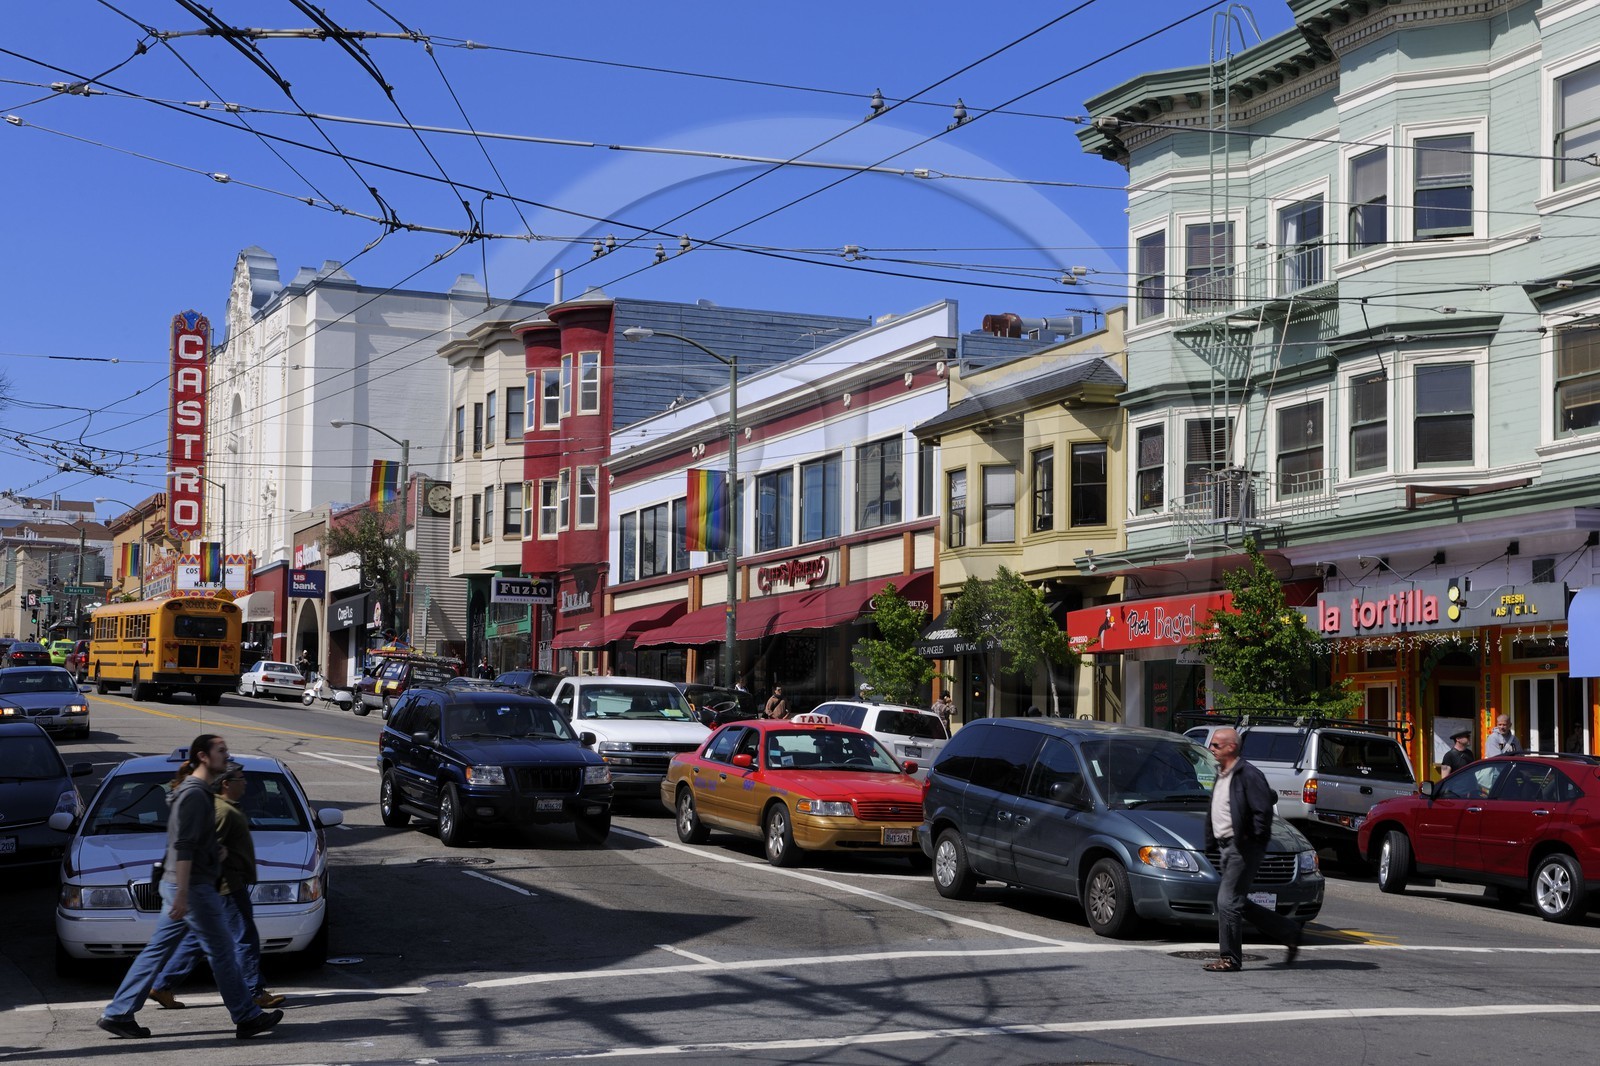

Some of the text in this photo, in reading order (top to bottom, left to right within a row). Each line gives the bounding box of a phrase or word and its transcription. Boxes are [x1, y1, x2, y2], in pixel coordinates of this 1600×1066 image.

[173, 334, 203, 526] CASTRO
[293, 581, 317, 590] bank
[500, 582, 548, 596] Fuzio
[185, 600, 218, 610] SCHOOL BUS
[561, 590, 590, 609] Fuzio
[1501, 594, 1525, 605] FRESH
[1318, 588, 1439, 632] la tortilla
[1126, 609, 1150, 641] Posh
[1154, 604, 1196, 643] Bagel
[918, 646, 927, 655] LOS
[927, 645, 944, 654] ANGELES
[953, 643, 965, 652] NEW
[800, 715, 829, 724] TAXI
